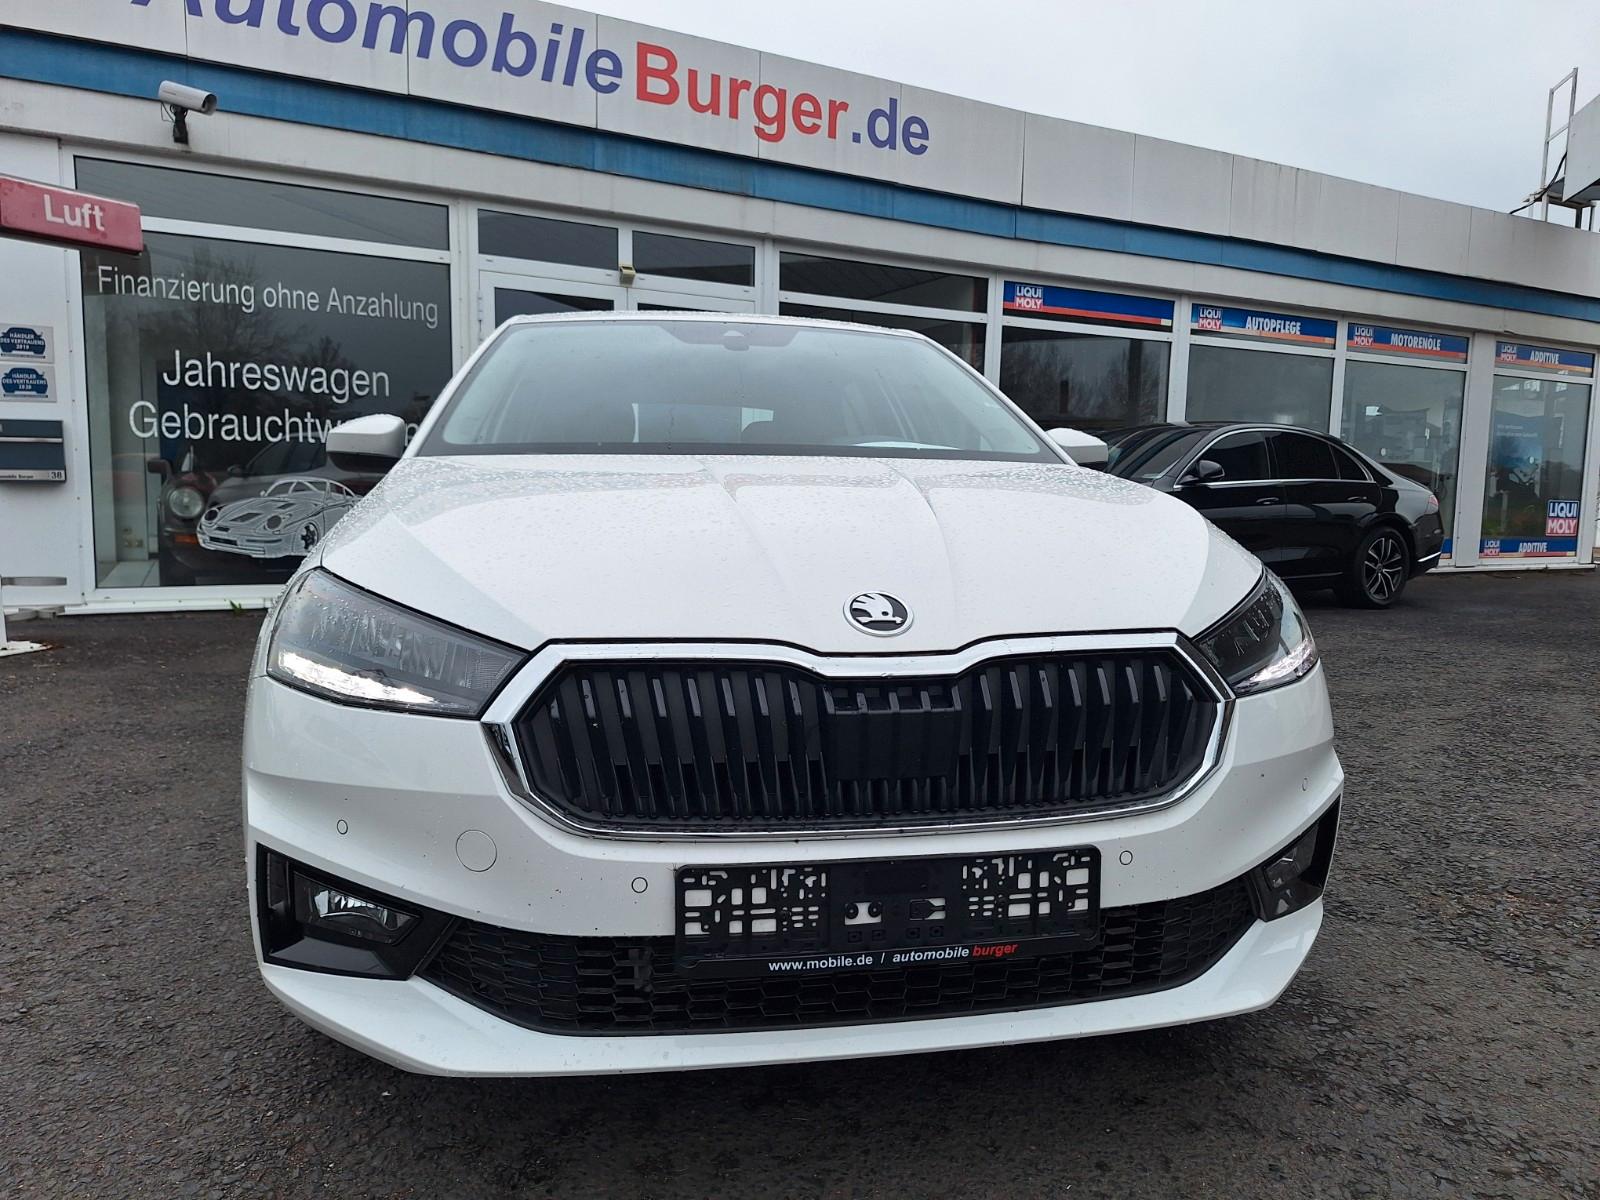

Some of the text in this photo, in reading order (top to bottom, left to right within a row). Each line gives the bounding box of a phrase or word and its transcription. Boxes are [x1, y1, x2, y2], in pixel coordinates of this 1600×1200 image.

[130, 0, 929, 155] utomobileBurger.de
[44, 194, 105, 231] Luft
[98, 266, 438, 329] Finanzierung ohne Anzahlung
[1016, 285, 1043, 299] LIQUI
[1015, 297, 1043, 309] MOLY
[1199, 307, 1222, 320] LIQUI
[1198, 318, 1222, 330] MOLY
[1245, 315, 1301, 335] AUTOPFLEGE
[1354, 327, 1374, 337] LIQUI
[1354, 336, 1374, 346] MOLY
[1500, 352, 1518, 362] MOLY
[1530, 350, 1560, 365] ADDITIVE
[163, 350, 390, 403] Jahreswagen
[1549, 502, 1577, 518] LIQUI
[1547, 519, 1577, 534] MOLY
[1518, 542, 1548, 553] ADDITIVE
[768, 955, 873, 972] www.mobile.de
